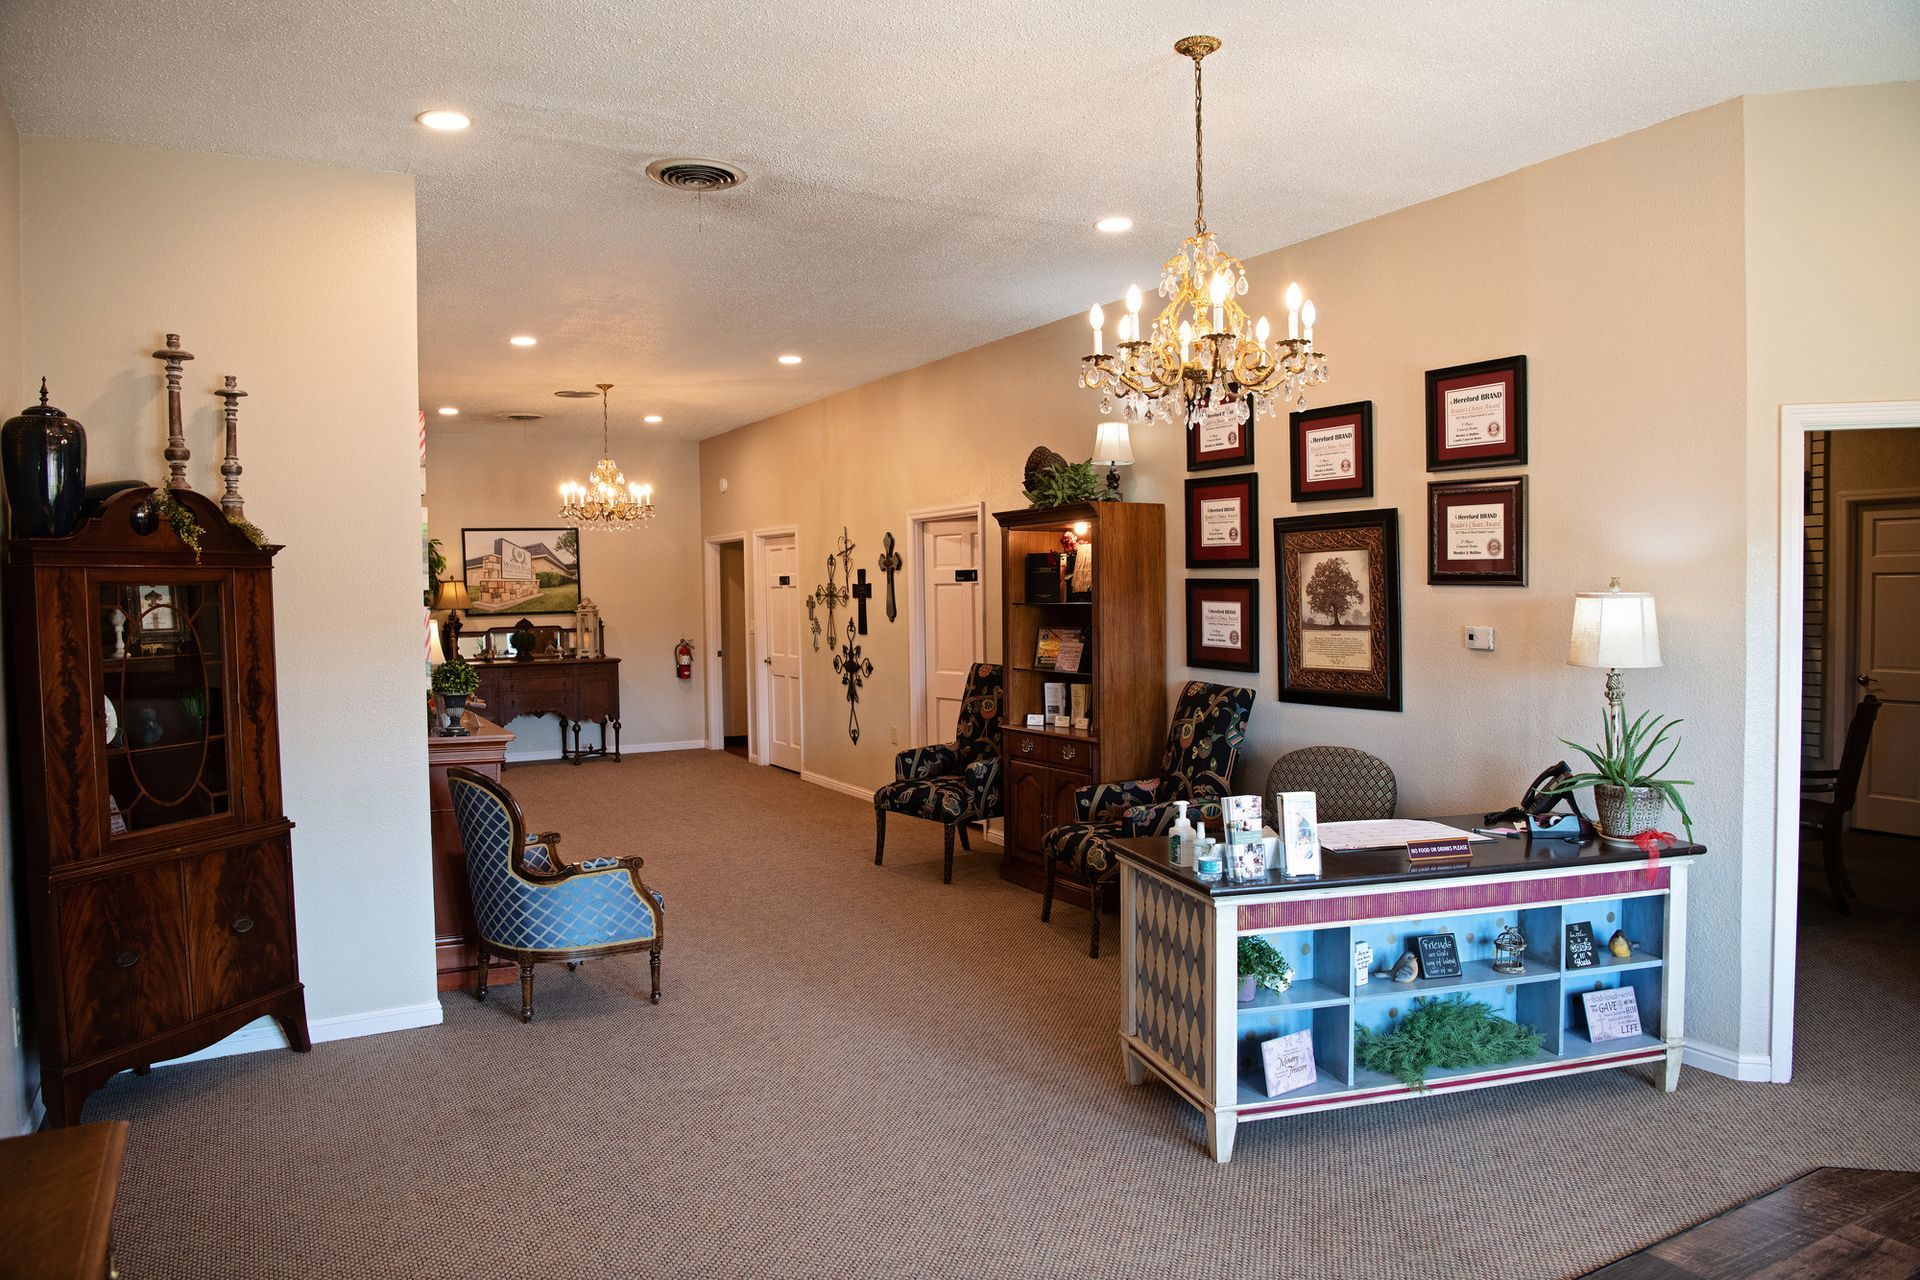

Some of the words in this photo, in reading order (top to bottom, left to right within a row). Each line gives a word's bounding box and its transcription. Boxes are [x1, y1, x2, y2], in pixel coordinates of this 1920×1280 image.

[1453, 394, 1479, 404] Hereford
[1480, 392, 1502, 400] BRAND
[1313, 434, 1334, 443] Hereford
[1423, 937, 1452, 950] Friends
[1599, 1001, 1617, 1012] GAVE
[1621, 1023, 1639, 1034] LIFE
